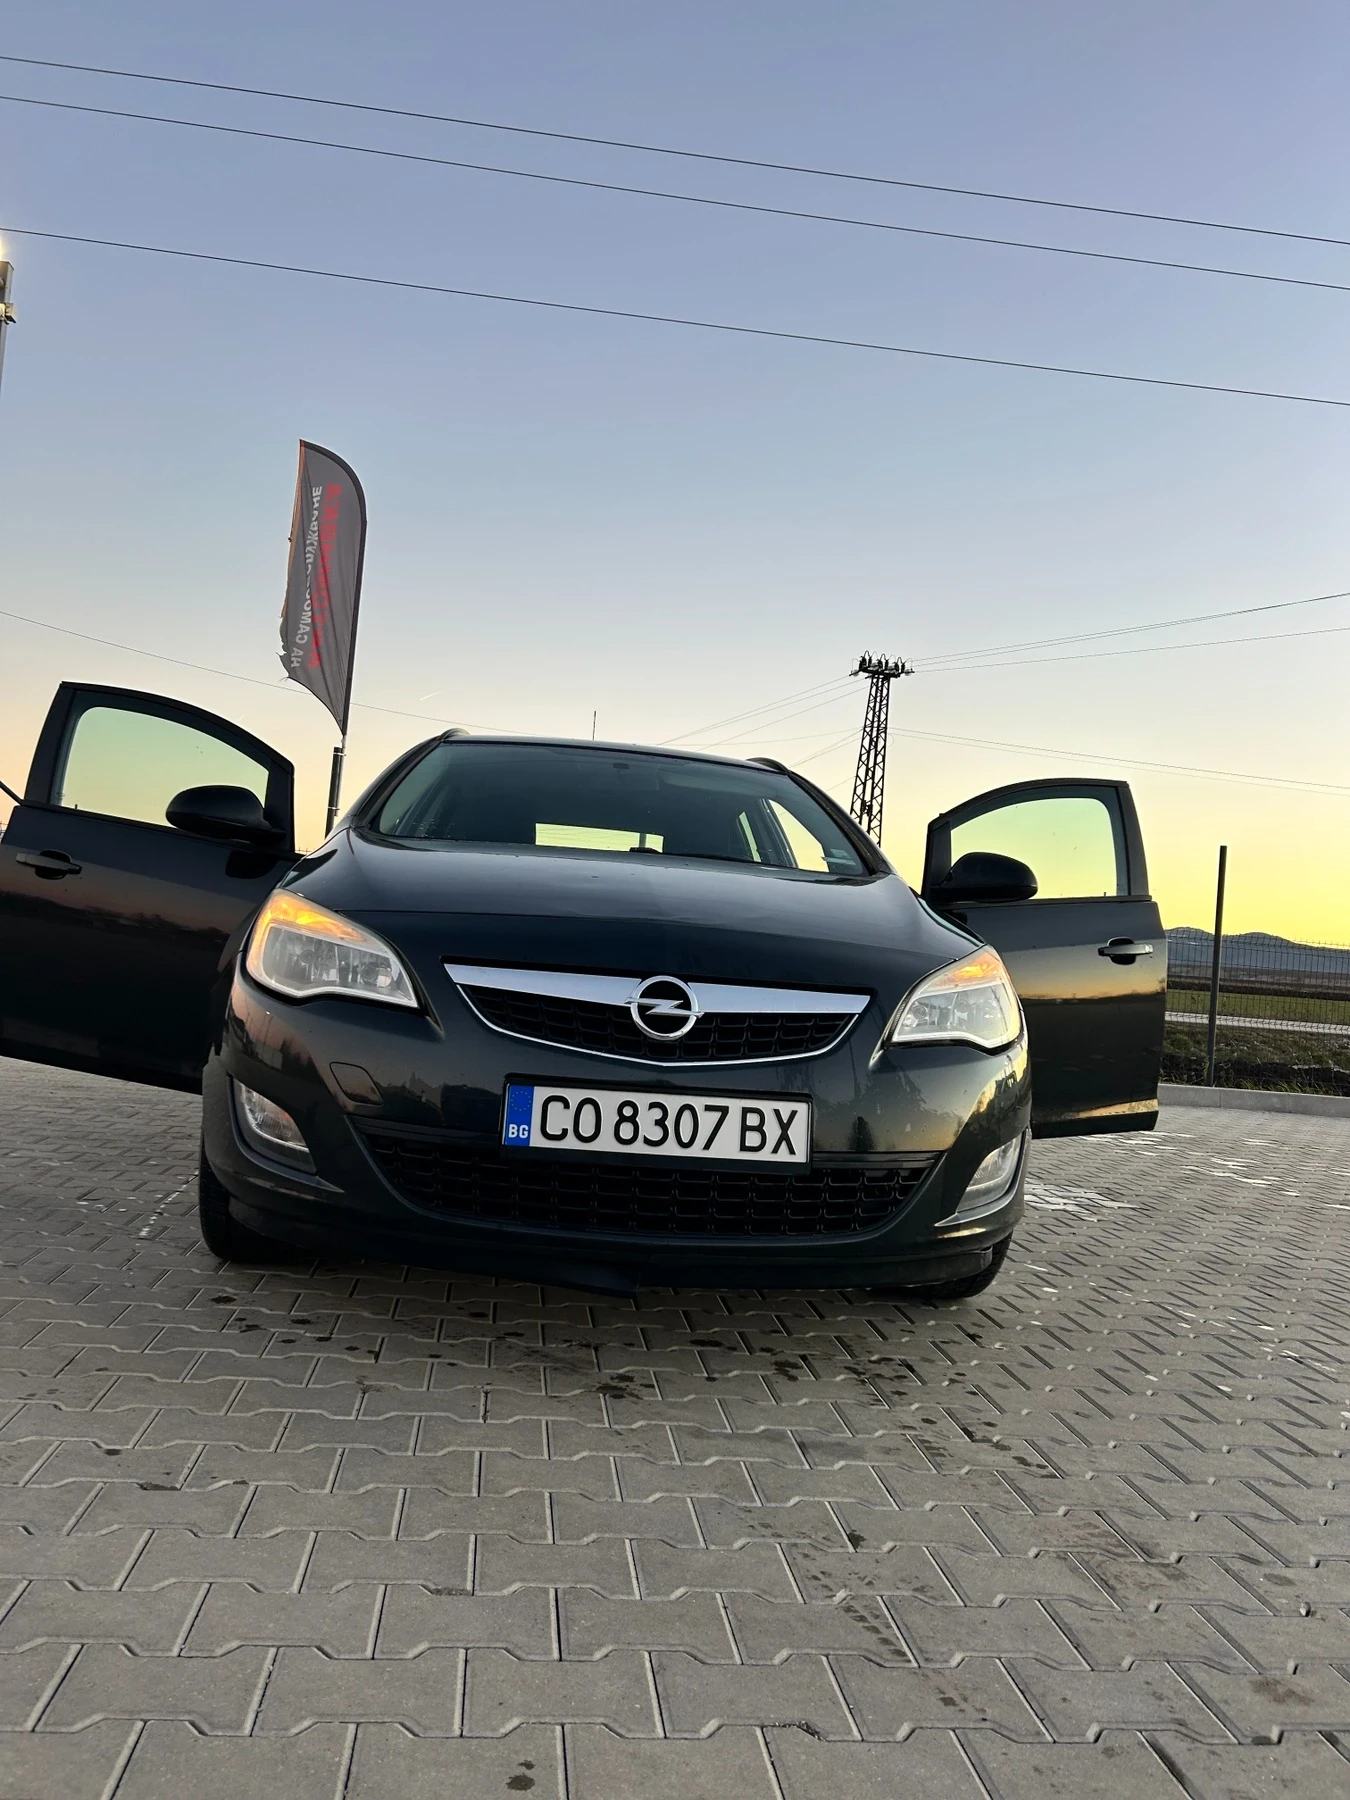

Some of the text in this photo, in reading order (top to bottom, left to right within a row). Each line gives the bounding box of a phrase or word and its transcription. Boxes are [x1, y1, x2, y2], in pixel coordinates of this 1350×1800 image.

[508, 1123, 529, 1139] BG
[540, 1094, 799, 1156] CO 8307 BX
